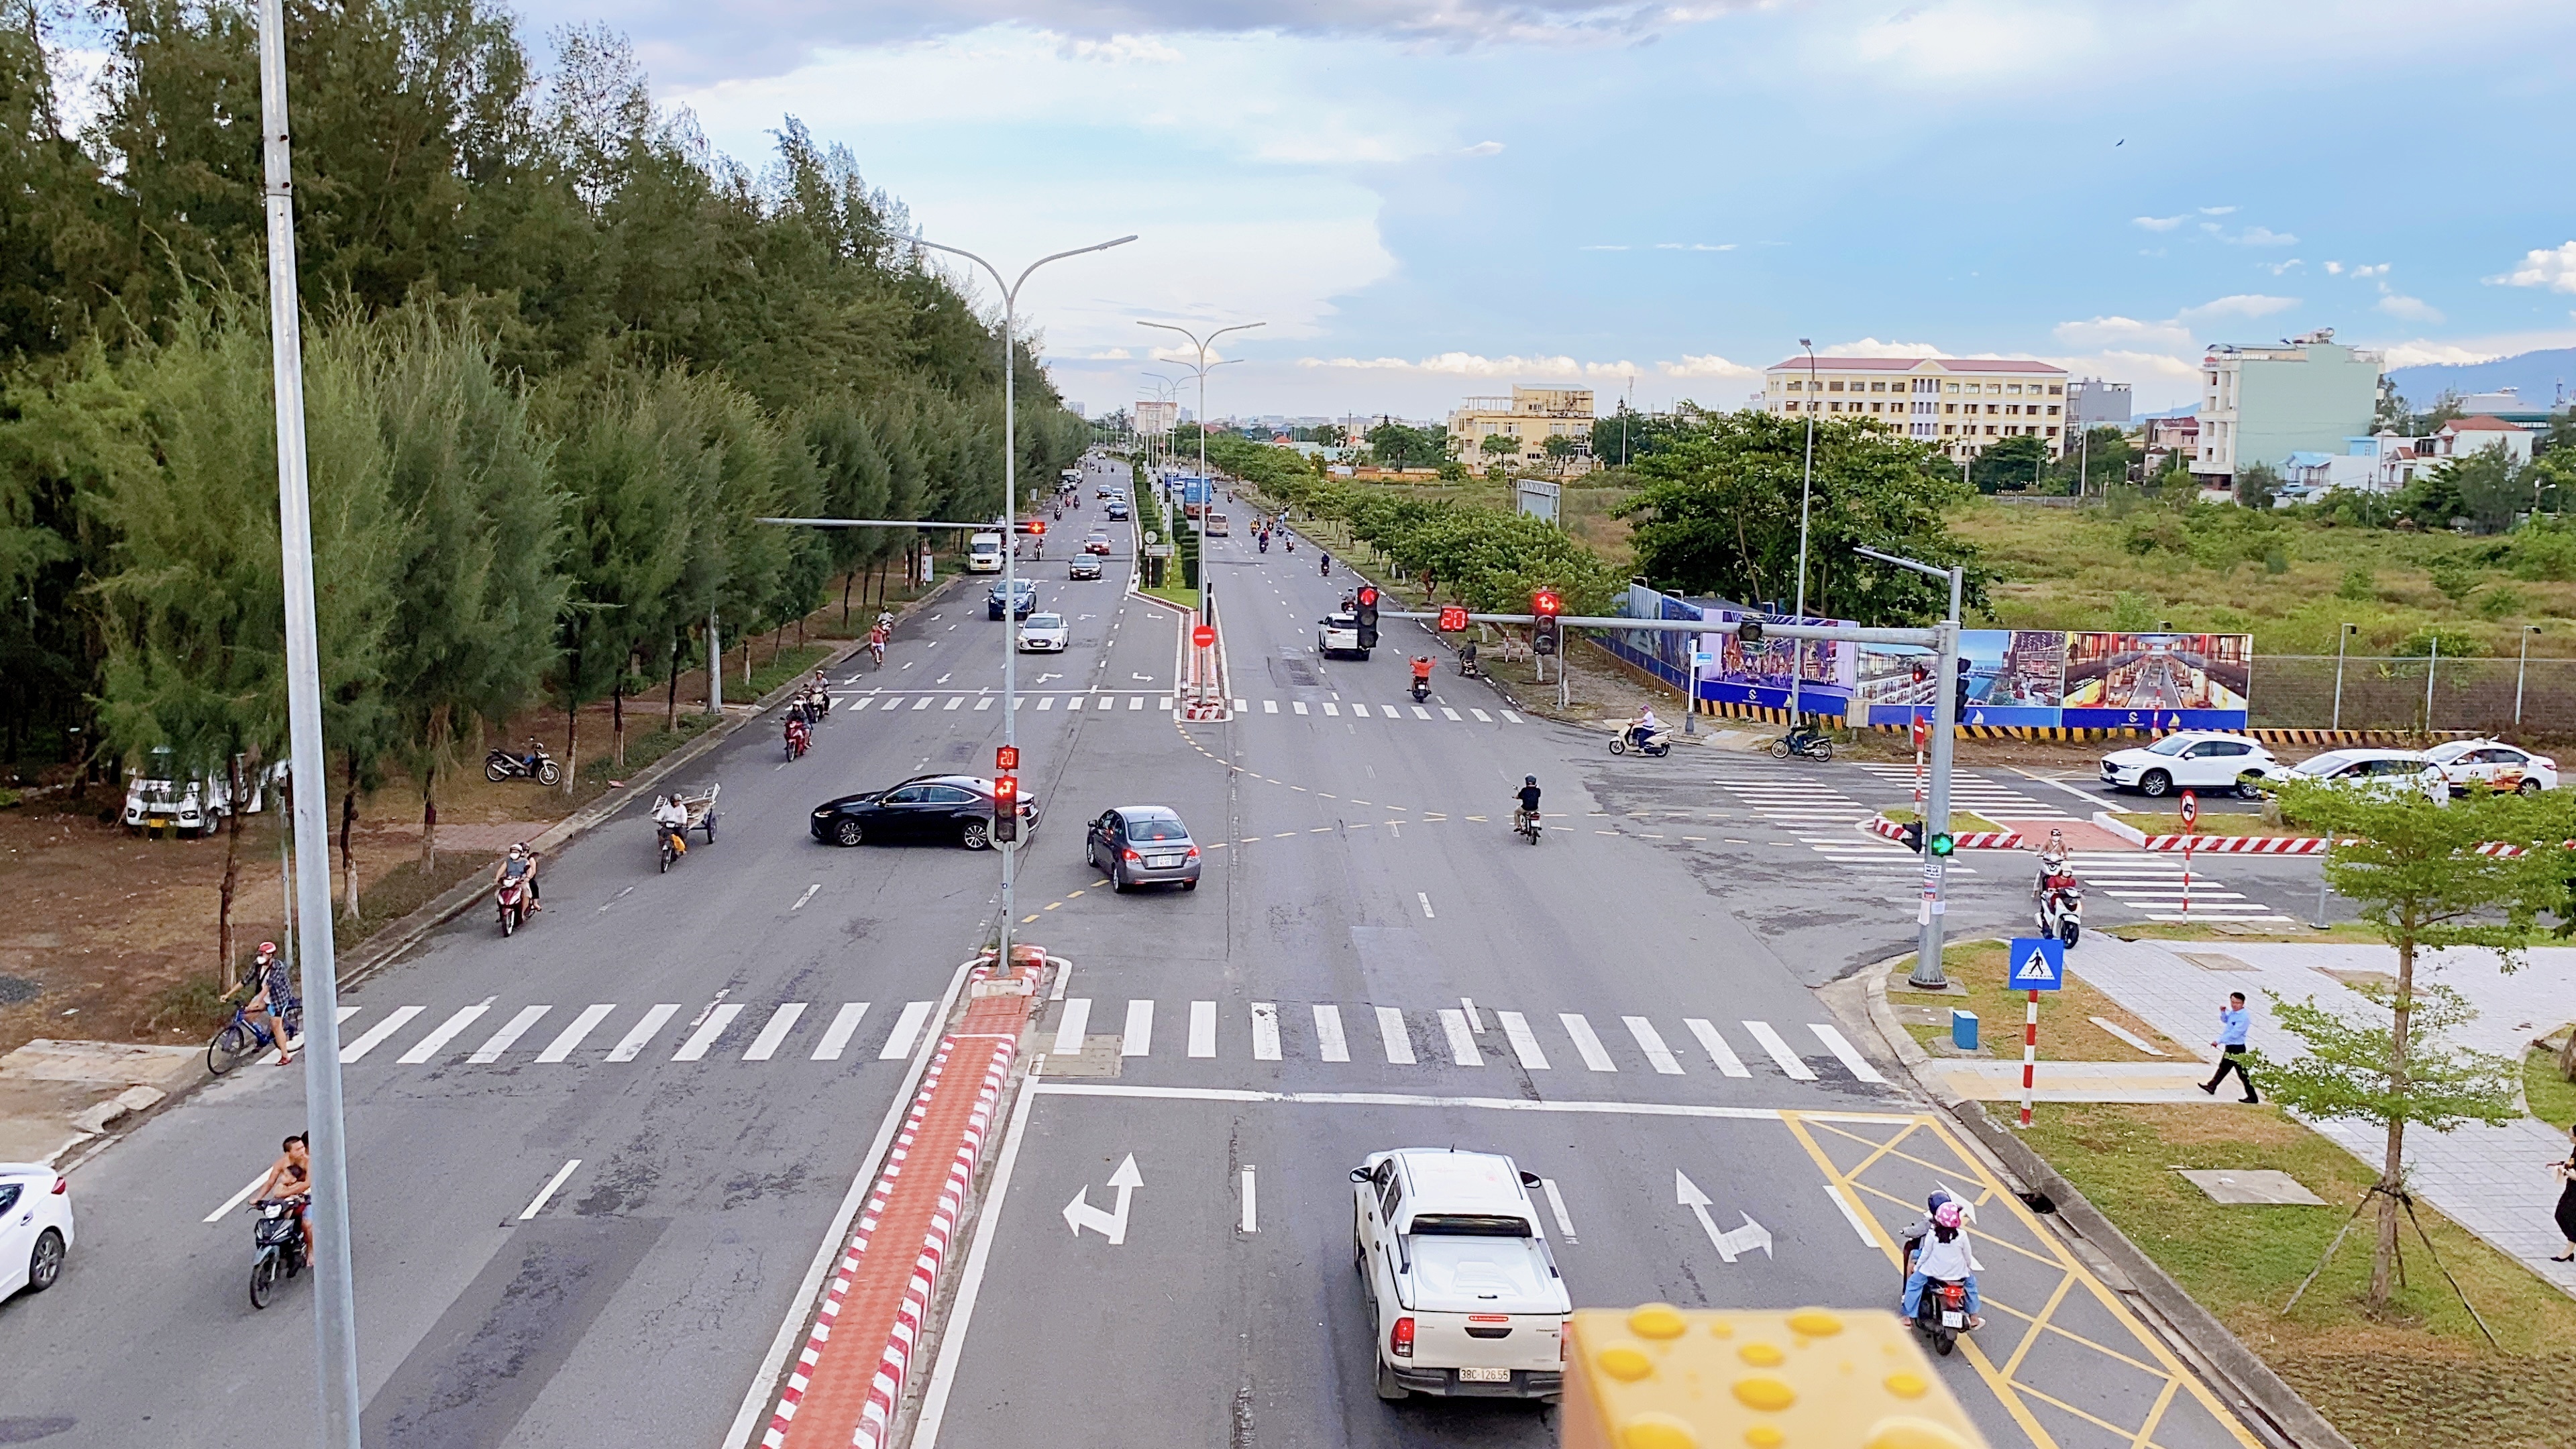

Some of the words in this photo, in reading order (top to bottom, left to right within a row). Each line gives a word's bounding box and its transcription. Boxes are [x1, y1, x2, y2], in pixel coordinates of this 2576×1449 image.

[1441, 610, 1465, 629] 20
[1000, 751, 1014, 765] 20
[1461, 1369, 1509, 1380] 38C-126.55
